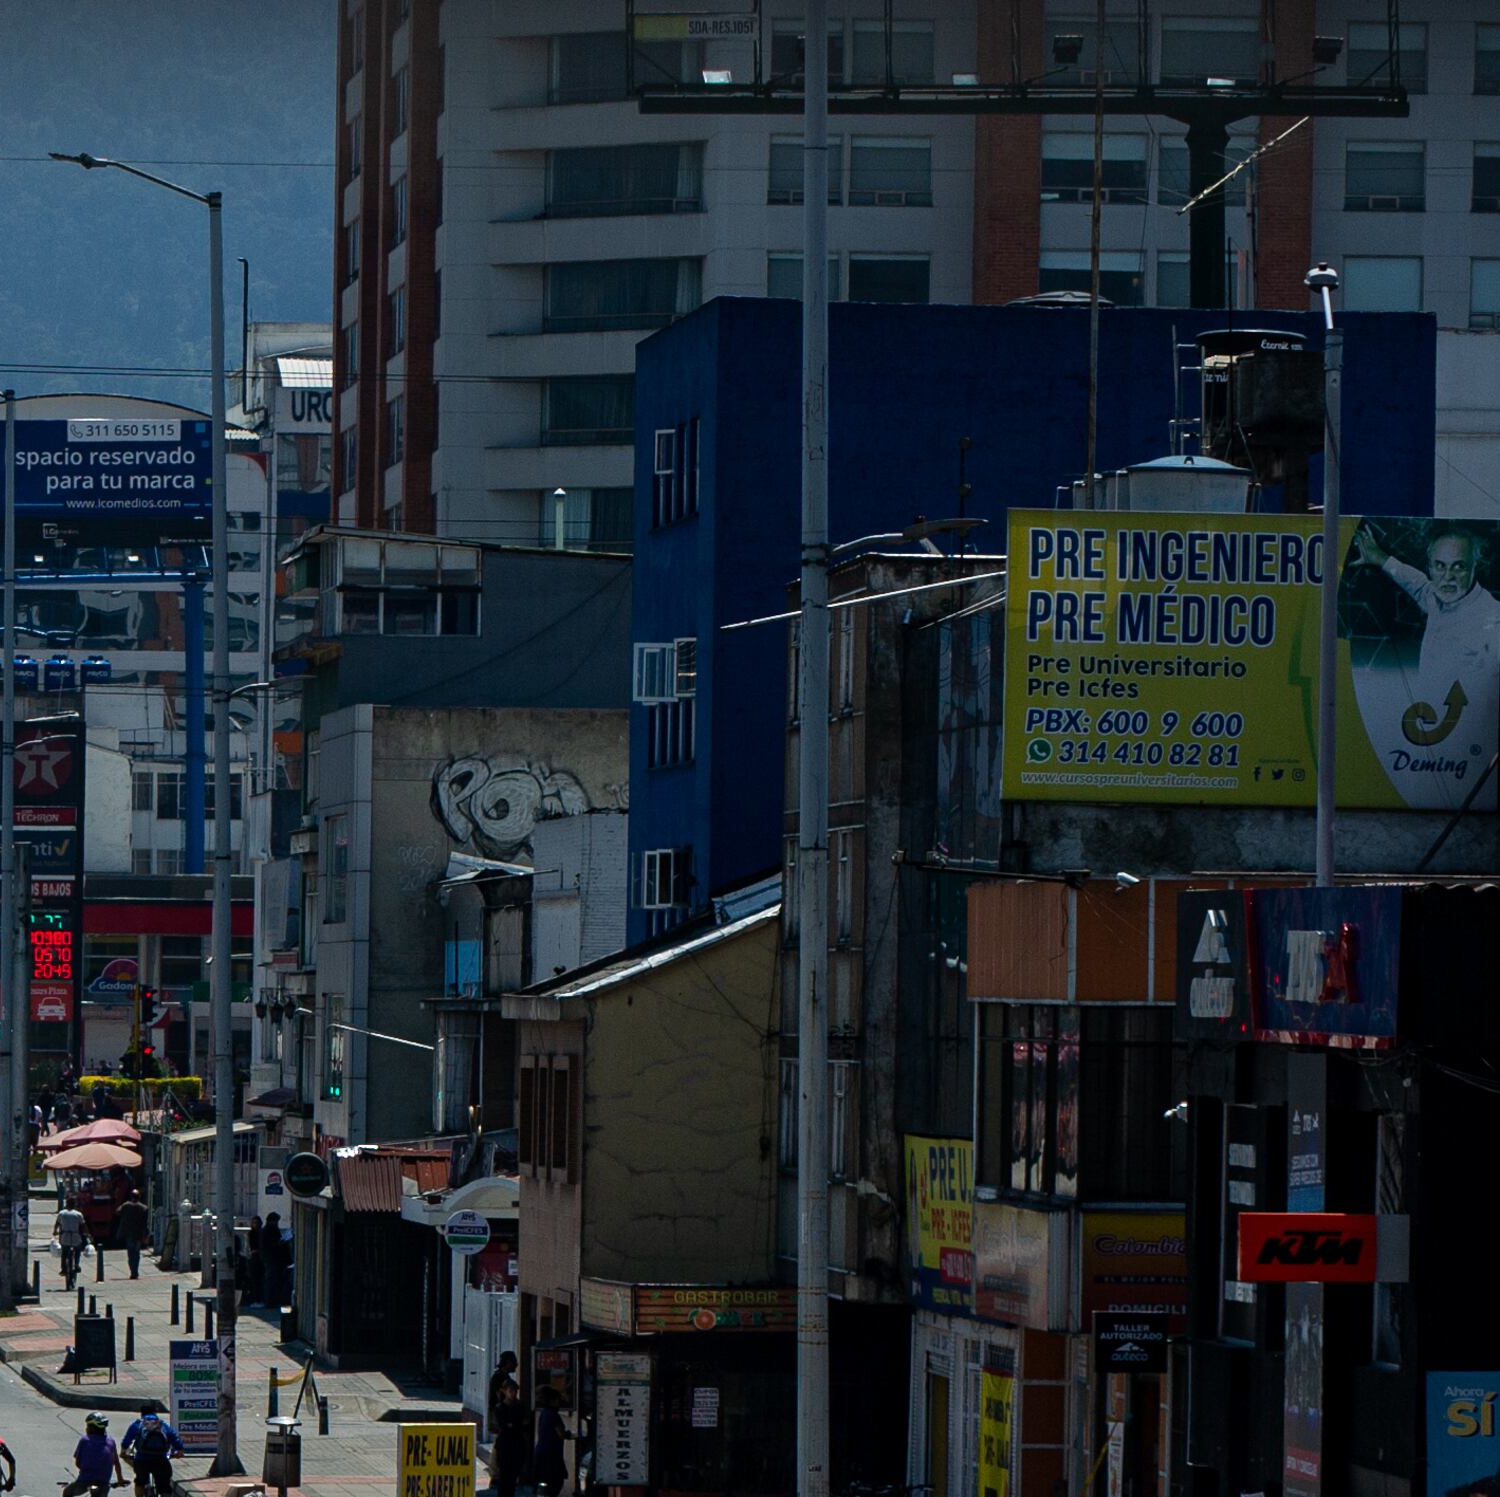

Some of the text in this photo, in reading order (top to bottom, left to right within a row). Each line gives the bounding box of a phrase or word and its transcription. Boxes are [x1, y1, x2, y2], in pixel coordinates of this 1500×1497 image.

[85, 424, 175, 437] 311 650 5115
[15, 446, 195, 471] spacio reservado
[46, 472, 195, 494] para tu marca
[66, 498, 181, 509] www.icomedios.com
[1027, 528, 1105, 580] PRE
[1026, 584, 1277, 648] PRE MÉDICO
[1028, 655, 1247, 678] Pre Universitario
[1027, 678, 1139, 698] Pre Icfes
[1025, 708, 1244, 739] PBX: 600 9 600
[1058, 740, 1240, 767] 314 410 82 81
[1389, 750, 1468, 779] Deming
[1021, 772, 1239, 788] www.cursospreuniversitarios.com
[16, 811, 60, 823] TECHRON
[42, 882, 72, 897] BAJOS
[929, 1146, 955, 1200] PRE
[1257, 1229, 1363, 1264] KTM
[674, 1290, 778, 1305] GASTROBAR
[1100, 1332, 1163, 1340] AUTORIZADO
[1113, 1324, 1150, 1332] TALLER
[1111, 1353, 1149, 1361] auteco
[1444, 1387, 1484, 1397] Ahora
[1447, 1391, 1499, 1437] SÍ
[615, 1387, 633, 1480] ALMUERZOS
[407, 1436, 469, 1466] PRE- U.NAL
